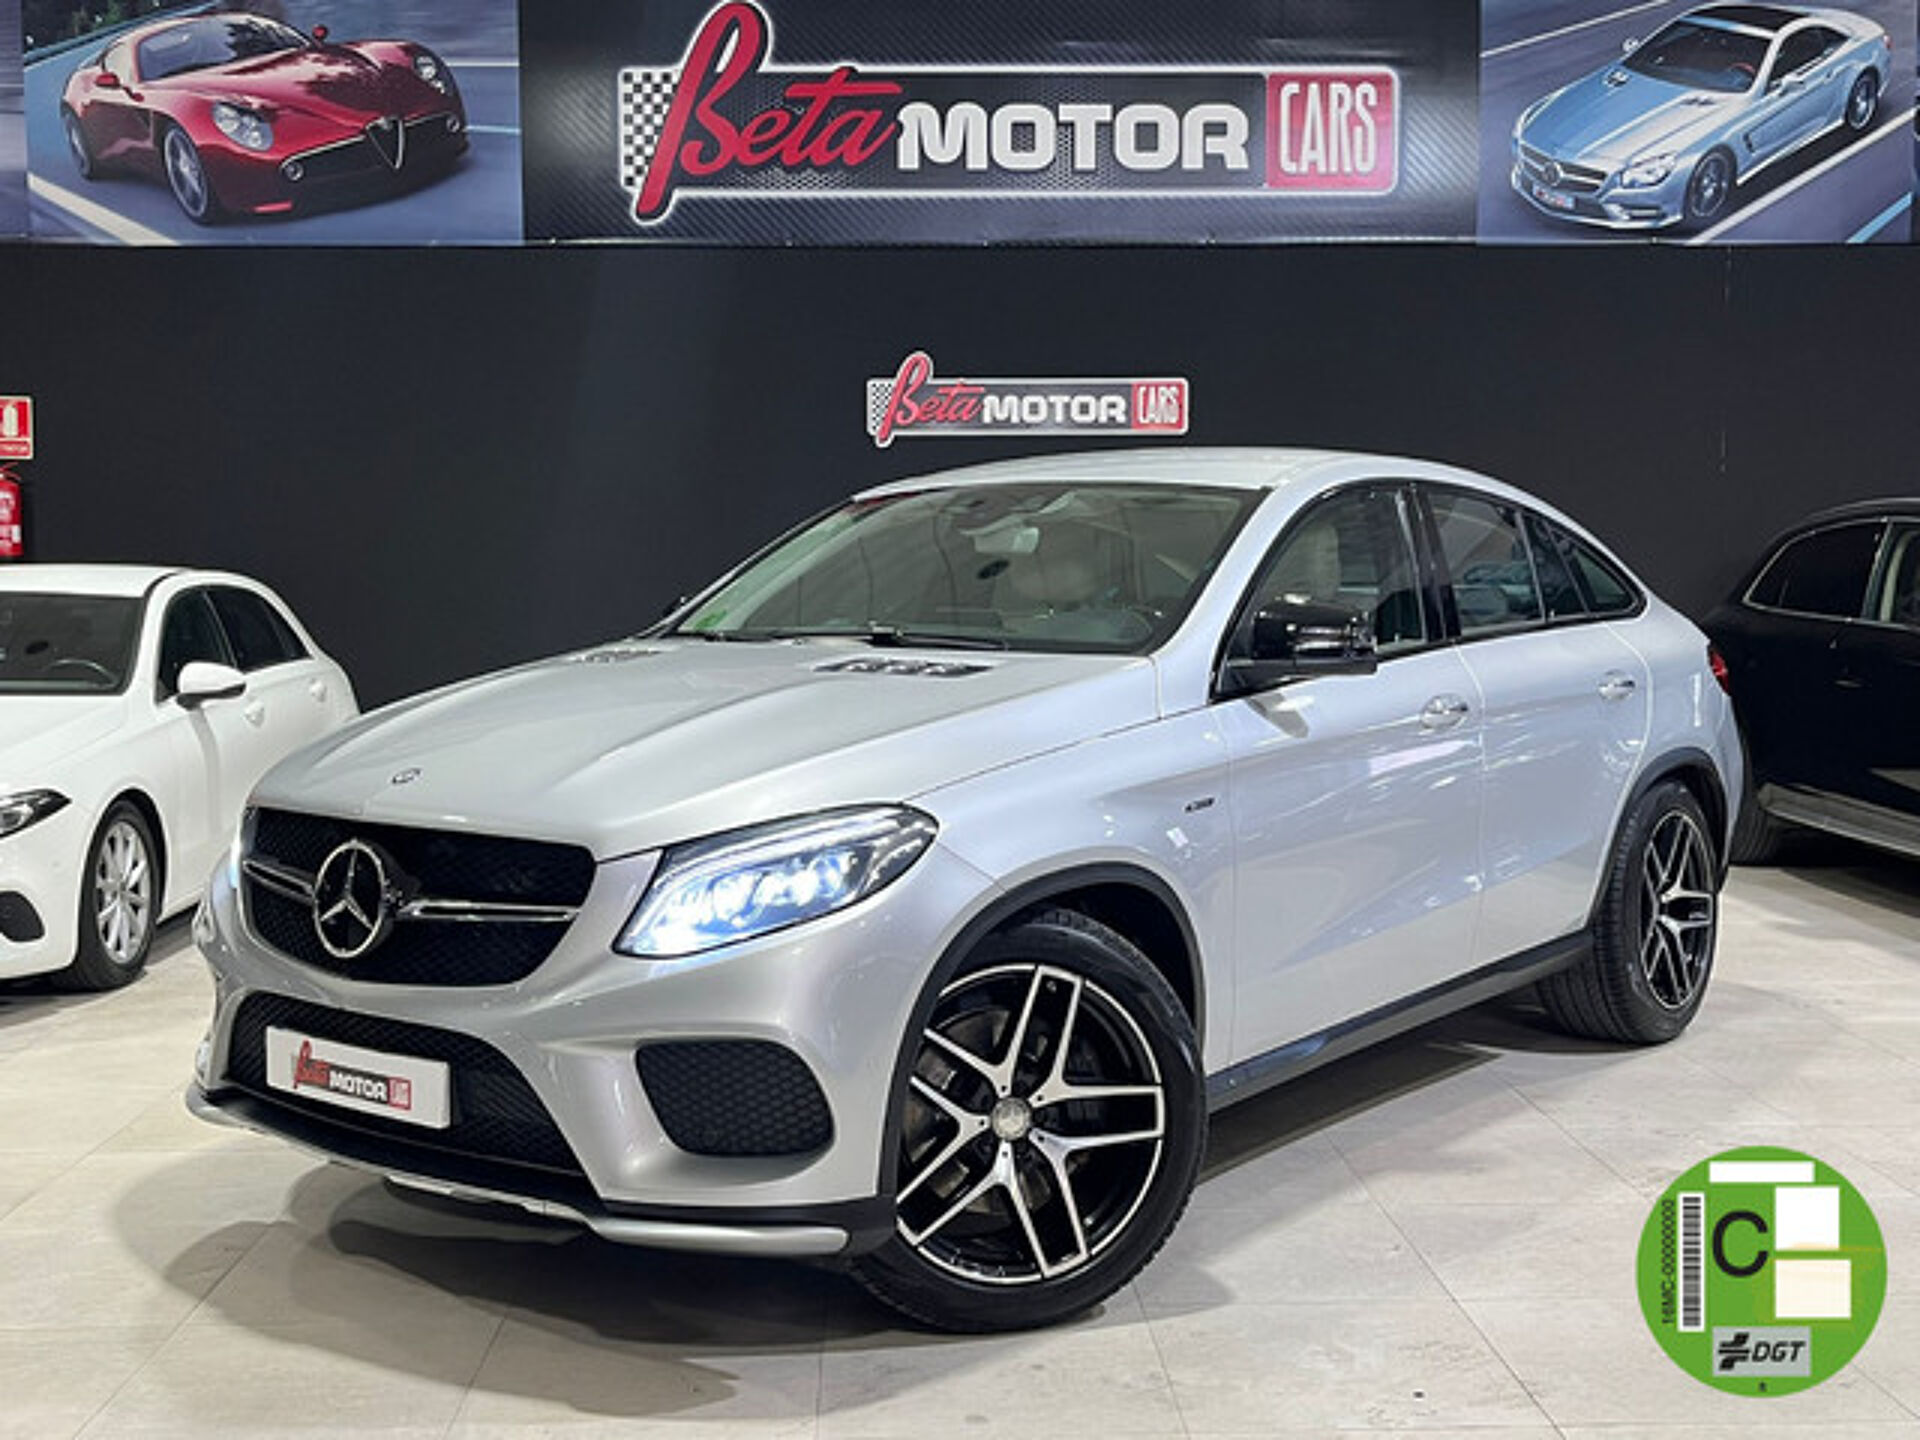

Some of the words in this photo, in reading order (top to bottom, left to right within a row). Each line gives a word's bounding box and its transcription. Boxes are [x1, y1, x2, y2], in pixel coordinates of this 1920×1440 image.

[635, 0, 903, 215] Beta
[896, 100, 1249, 171] MOTOR
[1278, 81, 1380, 176] CARS
[877, 353, 986, 441] Beta
[982, 394, 1126, 425] MOTOR
[1137, 385, 1181, 425] CARS
[329, 1070, 388, 1102] MOTOR
